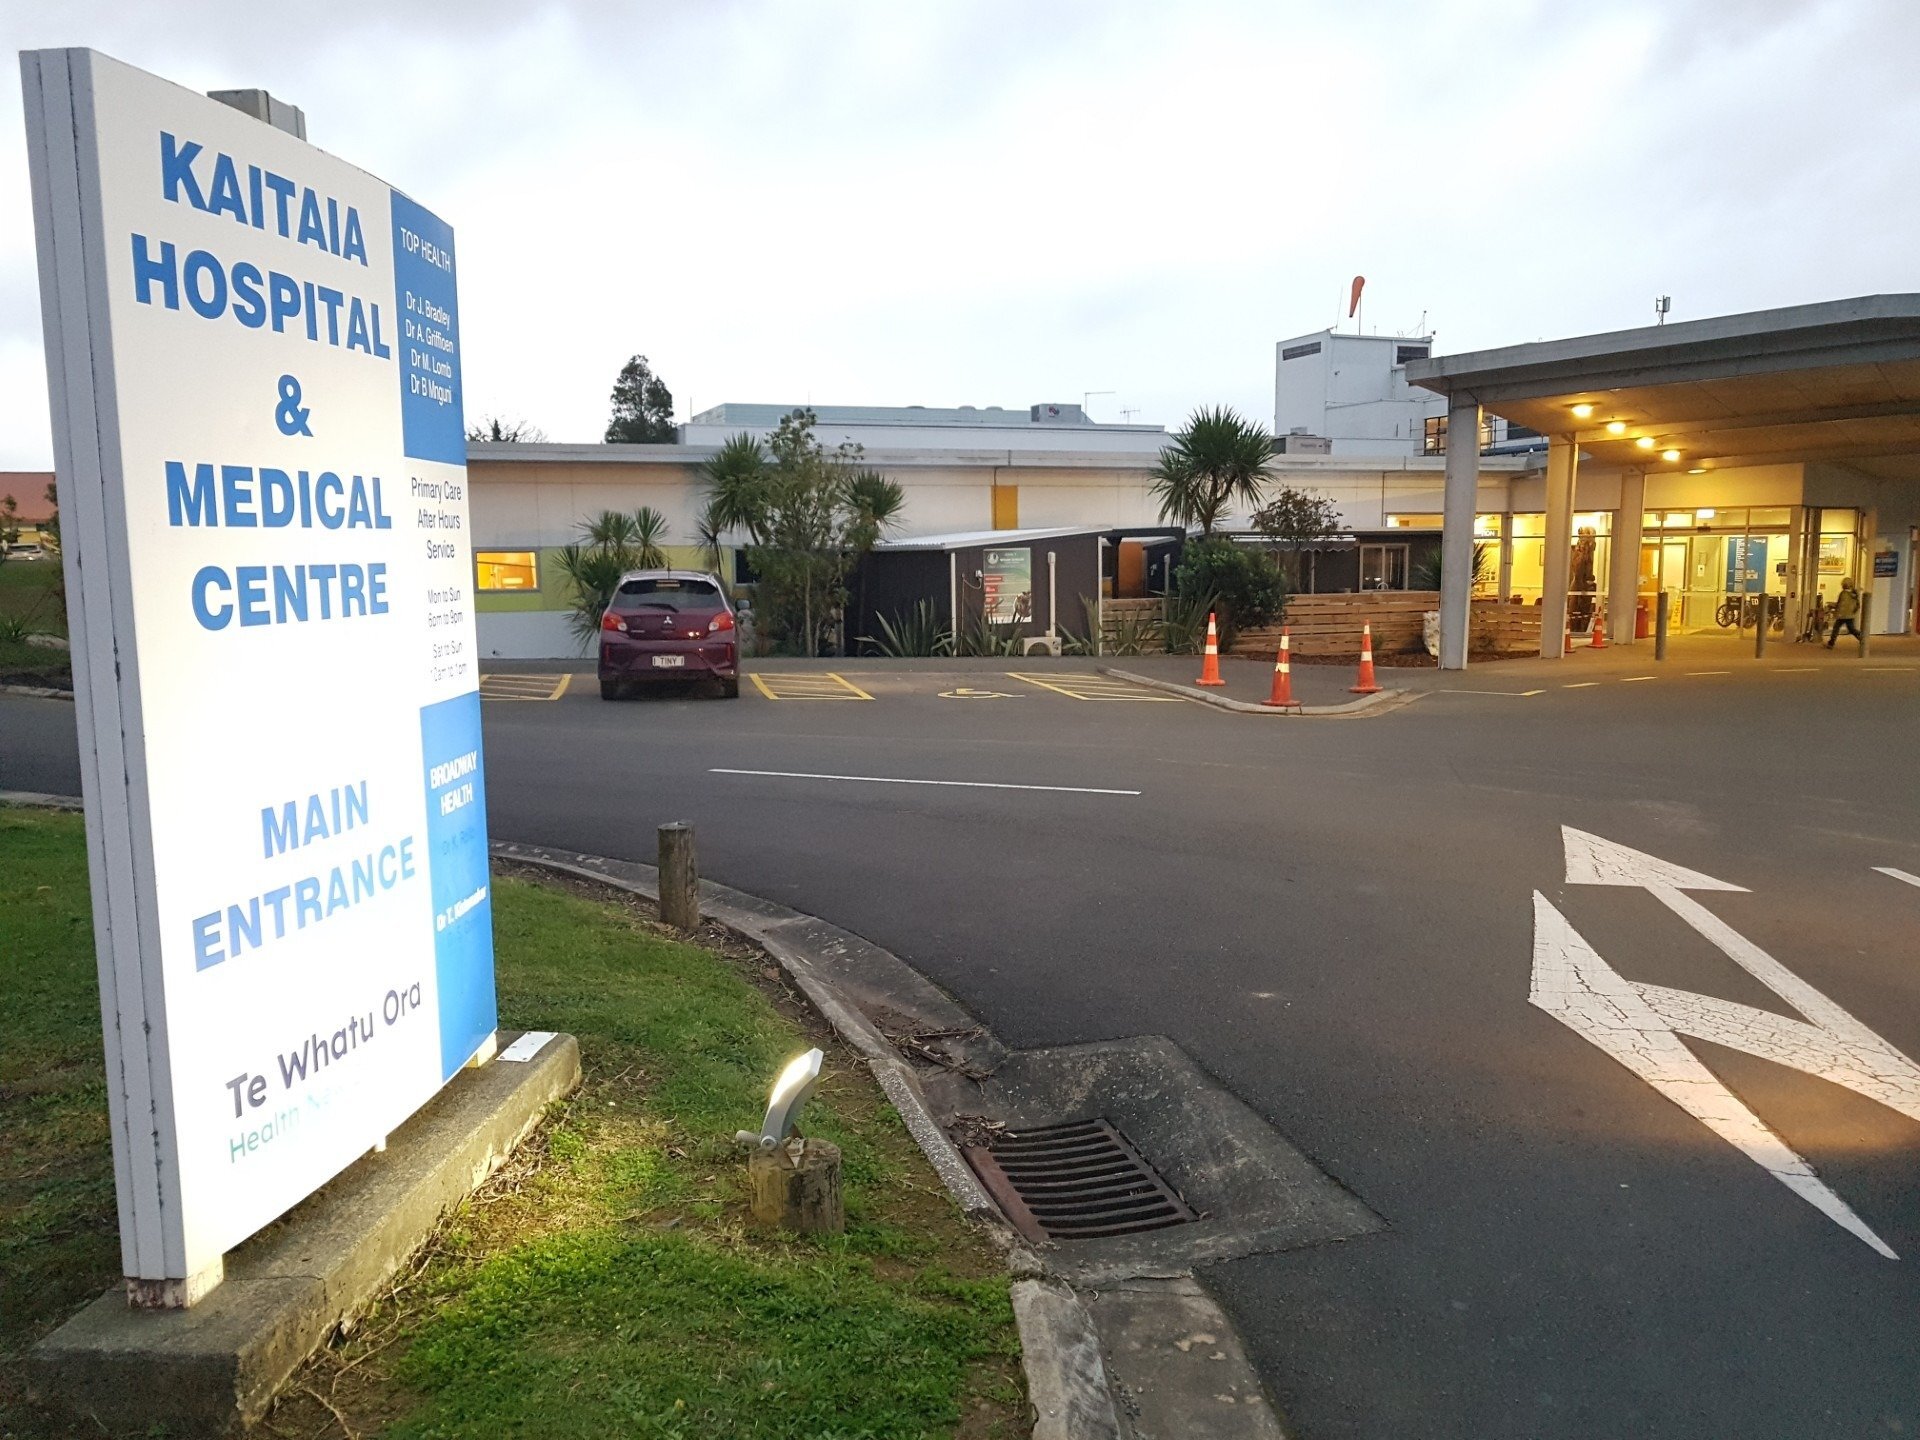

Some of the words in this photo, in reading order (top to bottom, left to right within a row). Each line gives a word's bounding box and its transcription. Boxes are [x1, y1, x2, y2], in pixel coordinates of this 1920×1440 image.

[160, 131, 368, 267] KAITAIA
[400, 227, 419, 254] TOP
[421, 239, 451, 273] HEALTH
[131, 232, 391, 360] HOSPITAL
[406, 290, 416, 311] Dr
[417, 296, 424, 316] J.
[425, 299, 451, 331] Bradley
[405, 318, 415, 338] Dr
[417, 323, 425, 343] A.
[410, 348, 421, 368] Dr
[422, 352, 431, 372] M.
[432, 356, 452, 379] Lomb
[274, 373, 314, 437] &
[410, 373, 420, 394] Dr
[421, 376, 428, 397] B
[165, 461, 392, 530] MEDICAL
[411, 476, 442, 505] Primary
[444, 480, 462, 501] Care
[417, 508, 436, 529] After
[438, 509, 461, 529] Hours
[426, 539, 455, 559] Service
[191, 562, 389, 631] CENTRE
[427, 588, 442, 604] Mon
[442, 590, 448, 602] to
[449, 586, 461, 602] Sun
[450, 640, 462, 655] Sun
[660, 657, 676, 665] TINY
[430, 750, 477, 789] BROADWAY
[261, 780, 369, 859] MAIN
[441, 782, 473, 817] HEALTH
[192, 835, 416, 972] ENTRANCE
[225, 1072, 267, 1118] Te
[277, 1011, 374, 1089] Whatu
[383, 981, 421, 1026] Ora
[229, 1105, 300, 1164] Health
